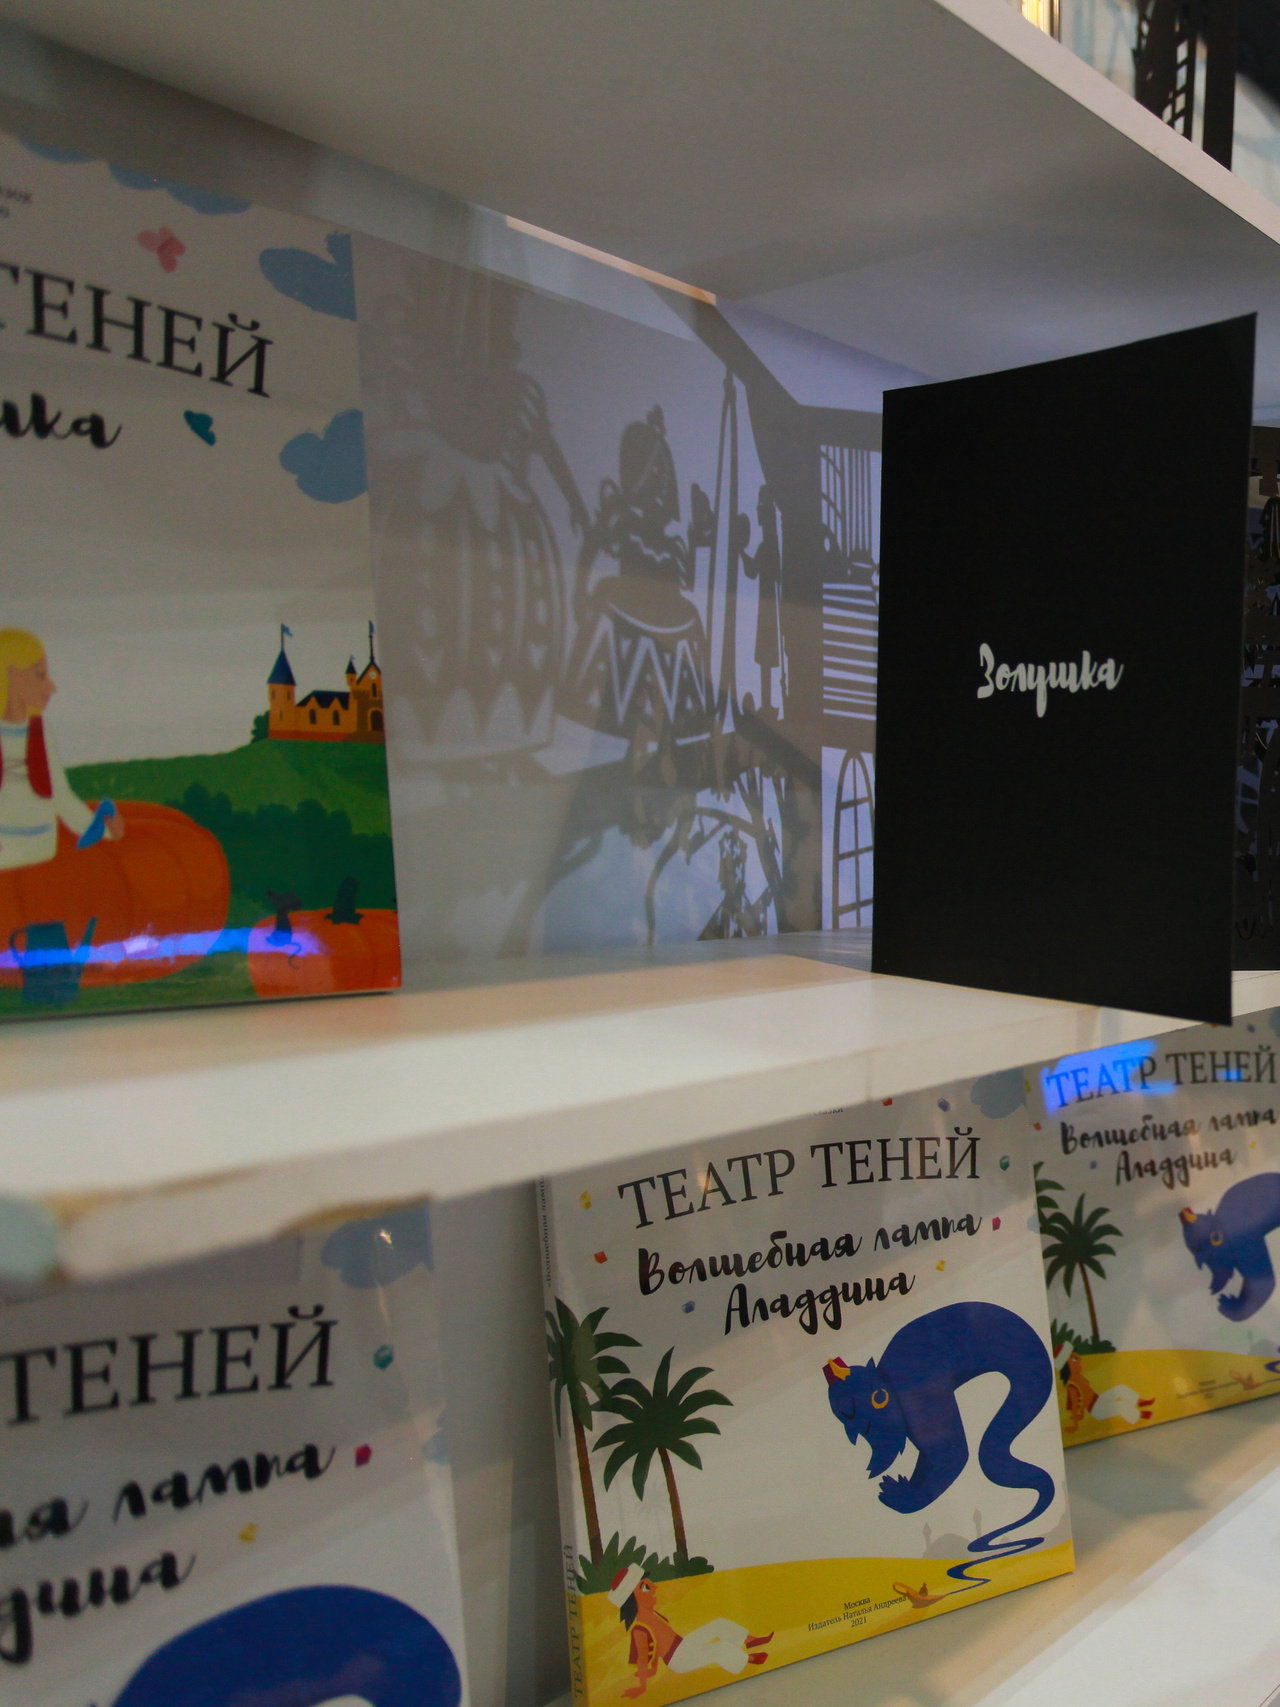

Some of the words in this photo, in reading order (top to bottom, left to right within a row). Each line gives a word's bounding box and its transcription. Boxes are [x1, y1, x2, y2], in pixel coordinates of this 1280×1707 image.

[977, 643, 1124, 718] Золушка
[1046, 1056, 1157, 1108] ТЕАТР
[1165, 1045, 1277, 1086] ТЕНЕЙ
[1060, 1114, 1203, 1155] Волшебная
[1208, 1108, 1280, 1132] лампа
[617, 1148, 795, 1229] ТЕАТР
[810, 1127, 981, 1188] ТЕНЕЙ
[1116, 1149, 1238, 1190] Аладдина
[637, 1231, 862, 1295] Волшебная
[874, 1212, 983, 1252] лампа
[725, 1271, 915, 1335] Аладдина
[0, 1305, 339, 1428] ТЕНЕЙ
[112, 1444, 336, 1522] лампа
[563, 1544, 579, 1621] ТЕНЕЙ
[808, 1615, 842, 1631] Издатель
[843, 1606, 872, 1620] Наталья
[873, 1595, 907, 1610] Андреева
[843, 1597, 871, 1611] Москва
[851, 1616, 867, 1628] 2021
[570, 1627, 583, 1698] ТЕАТР
